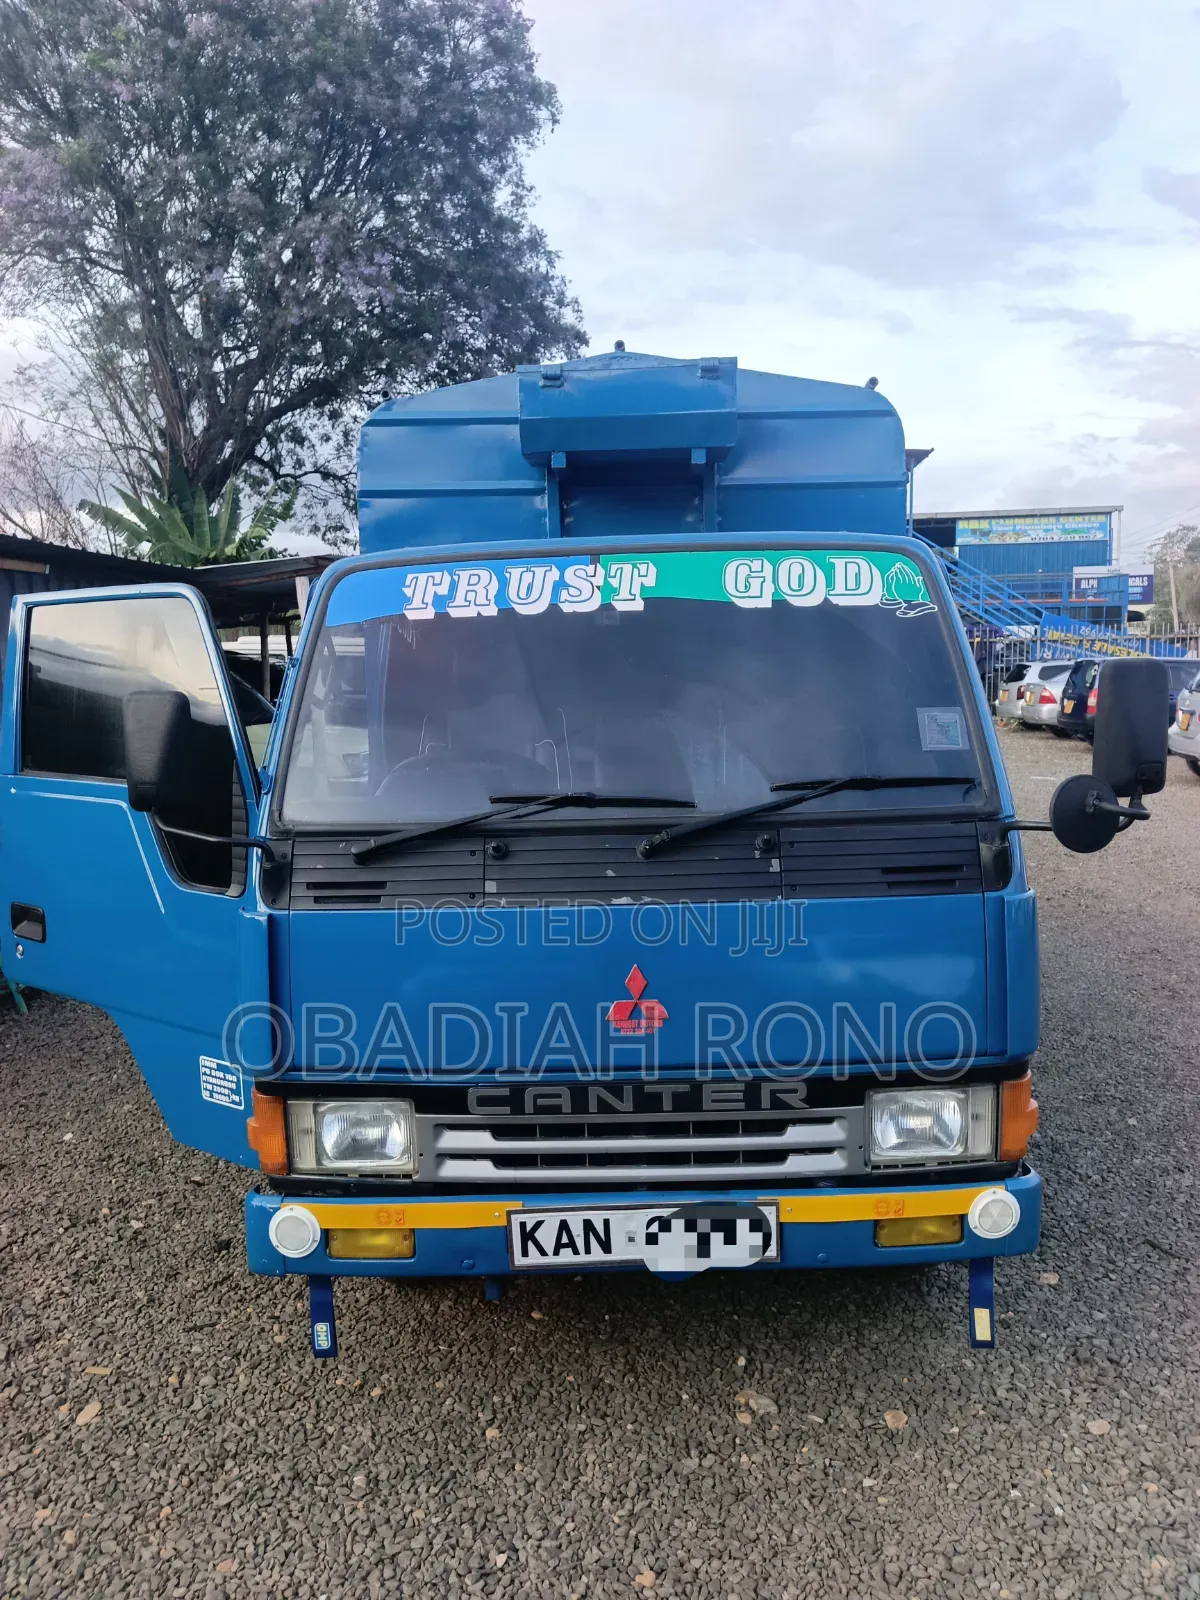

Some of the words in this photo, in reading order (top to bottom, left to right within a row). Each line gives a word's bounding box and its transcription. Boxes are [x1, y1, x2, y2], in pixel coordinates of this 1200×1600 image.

[402, 559, 657, 620] TRUST
[722, 556, 885, 608] GOD
[467, 1082, 810, 1115] CANTER
[519, 1217, 613, 1258] KAN
